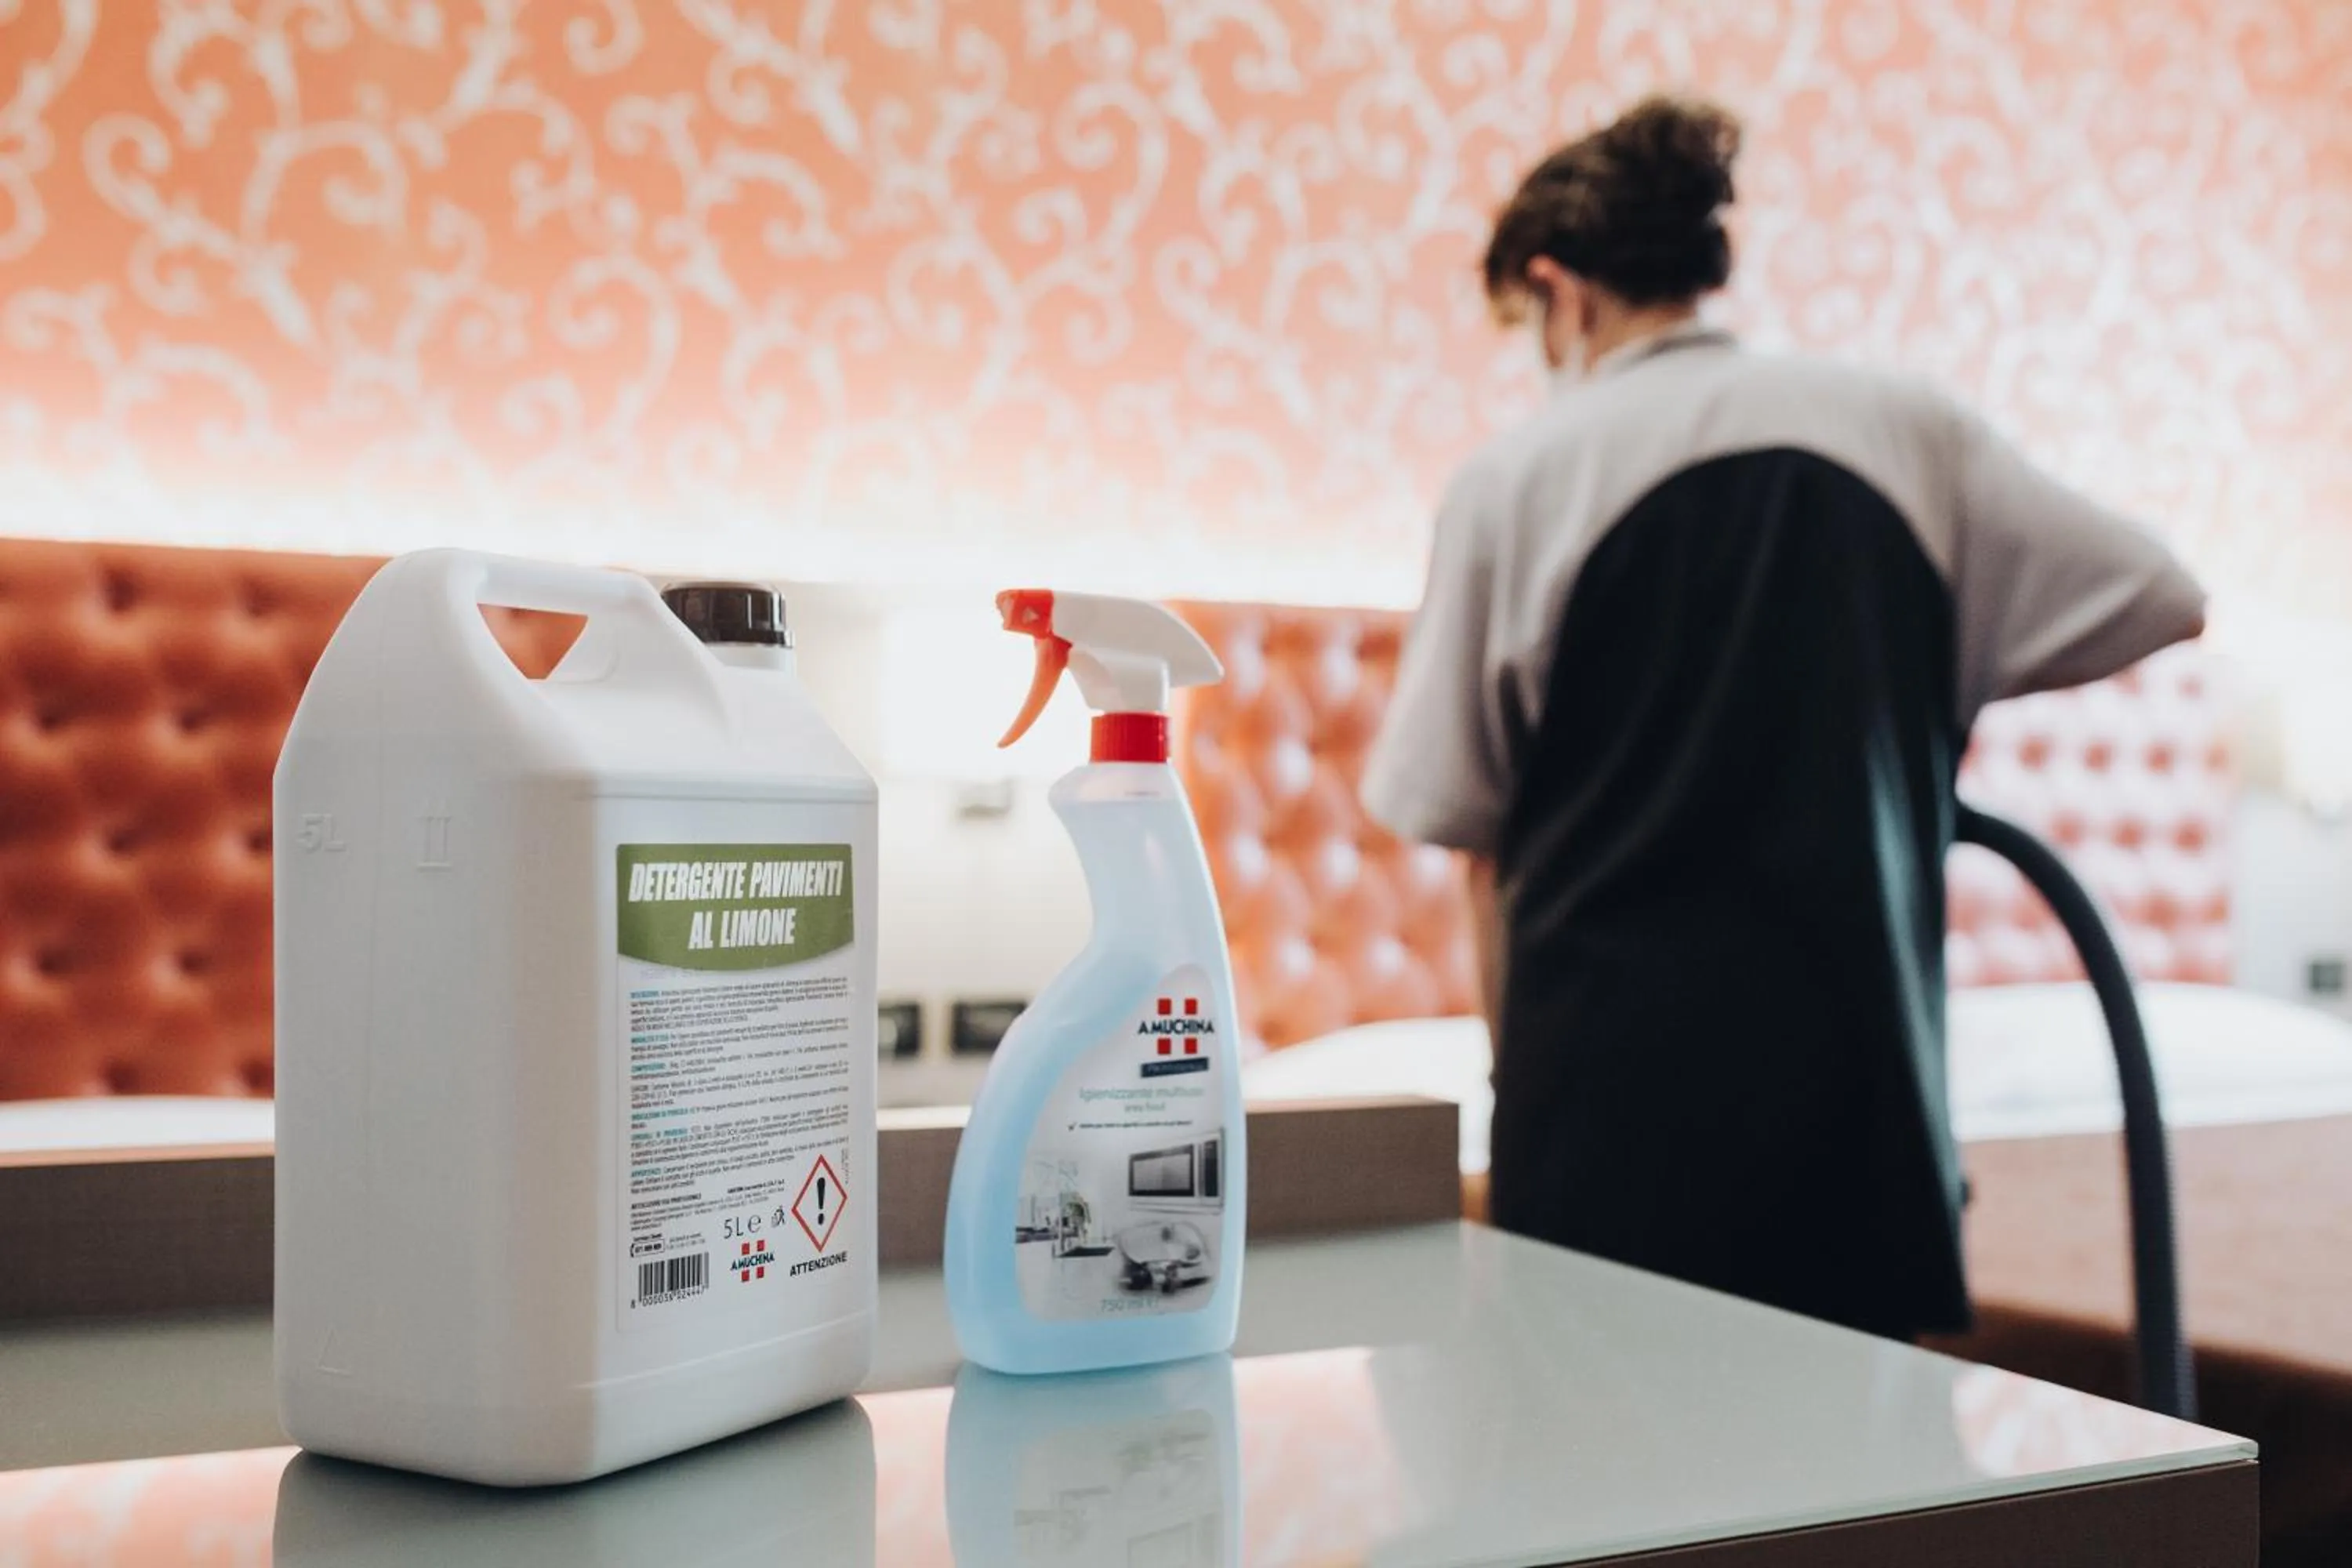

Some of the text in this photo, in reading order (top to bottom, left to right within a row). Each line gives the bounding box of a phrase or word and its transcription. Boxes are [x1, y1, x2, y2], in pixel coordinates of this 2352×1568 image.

[628, 860, 844, 902] DETERGENTE PAVIMENTI
[688, 908, 797, 949] AL LIMONE
[1138, 1019, 1215, 1035] AMUCHINA
[730, 1252, 776, 1272] AMUCHINA
[789, 1250, 848, 1277] ATTENZIONE
